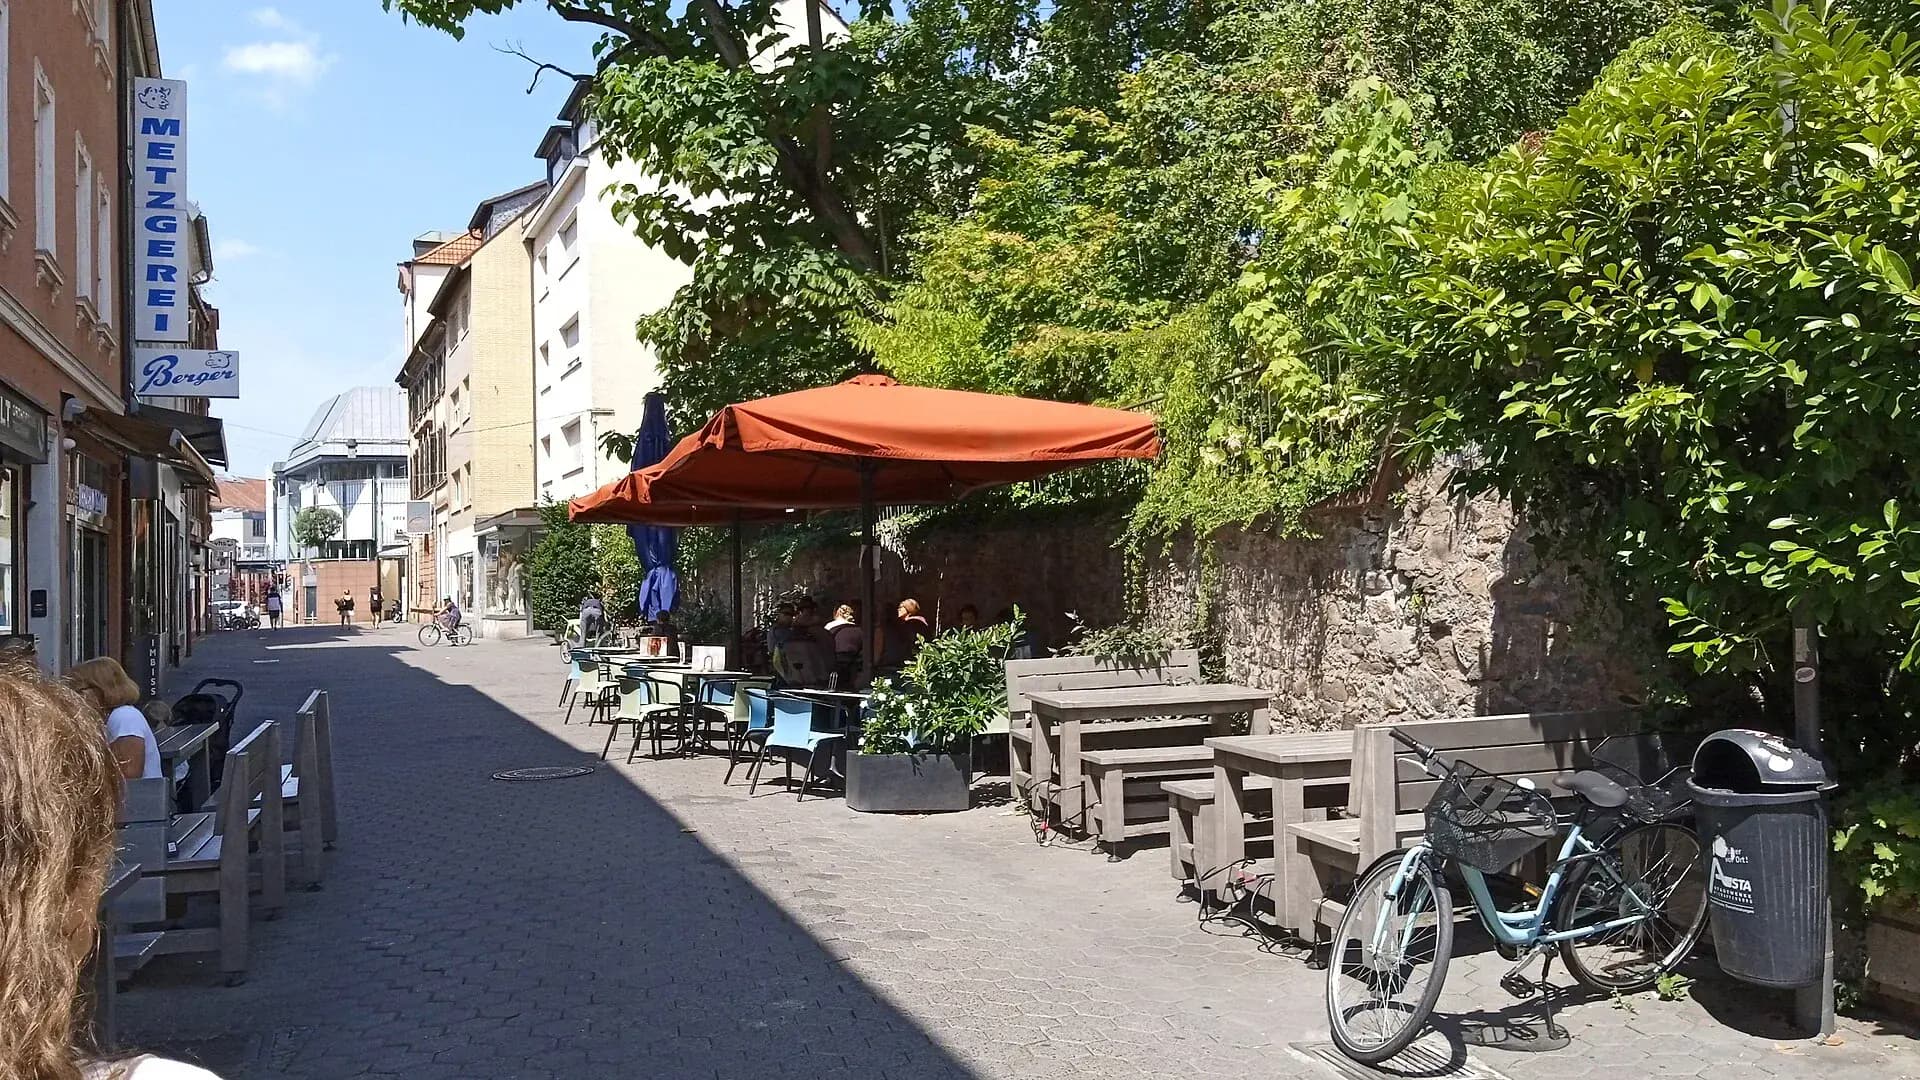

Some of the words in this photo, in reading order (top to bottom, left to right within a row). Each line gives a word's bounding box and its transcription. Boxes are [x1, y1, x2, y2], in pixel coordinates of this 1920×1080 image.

[141, 117, 180, 332] METZGEREI
[139, 354, 236, 393] Berger
[149, 639, 157, 696] IMBISS
[1735, 856, 1749, 864] Ort!
